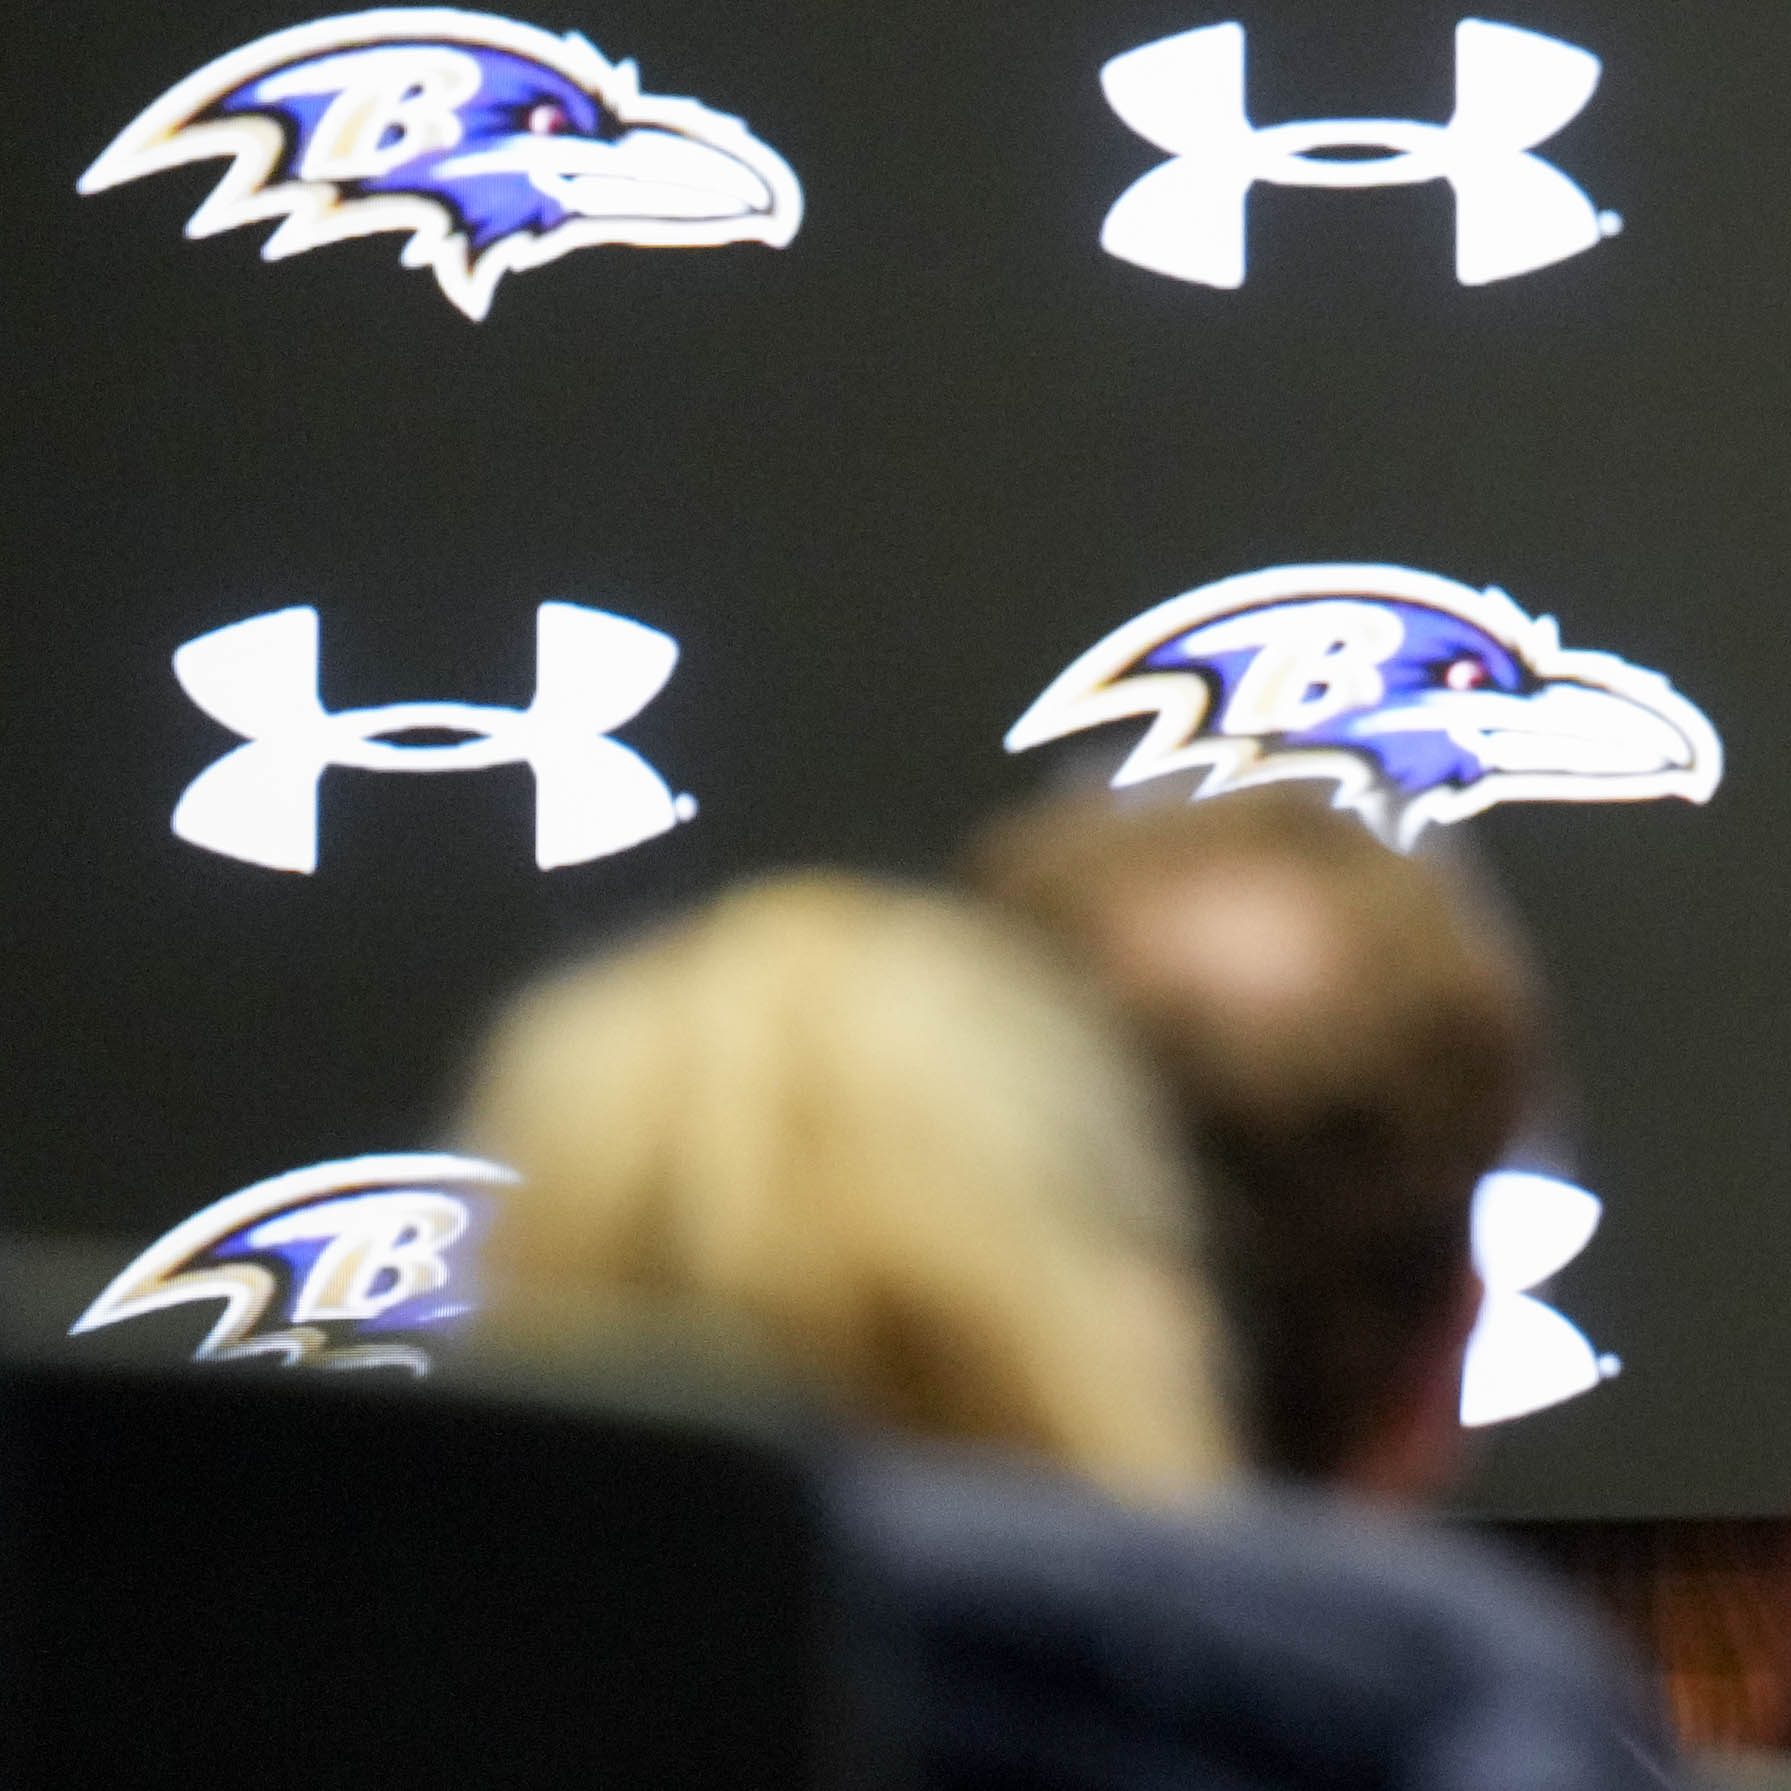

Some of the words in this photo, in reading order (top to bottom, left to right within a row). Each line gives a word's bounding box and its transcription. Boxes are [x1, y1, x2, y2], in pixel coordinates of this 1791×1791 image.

[254, 43, 481, 180] B
[1178, 599, 1405, 736] B
[248, 1190, 470, 1323] B
